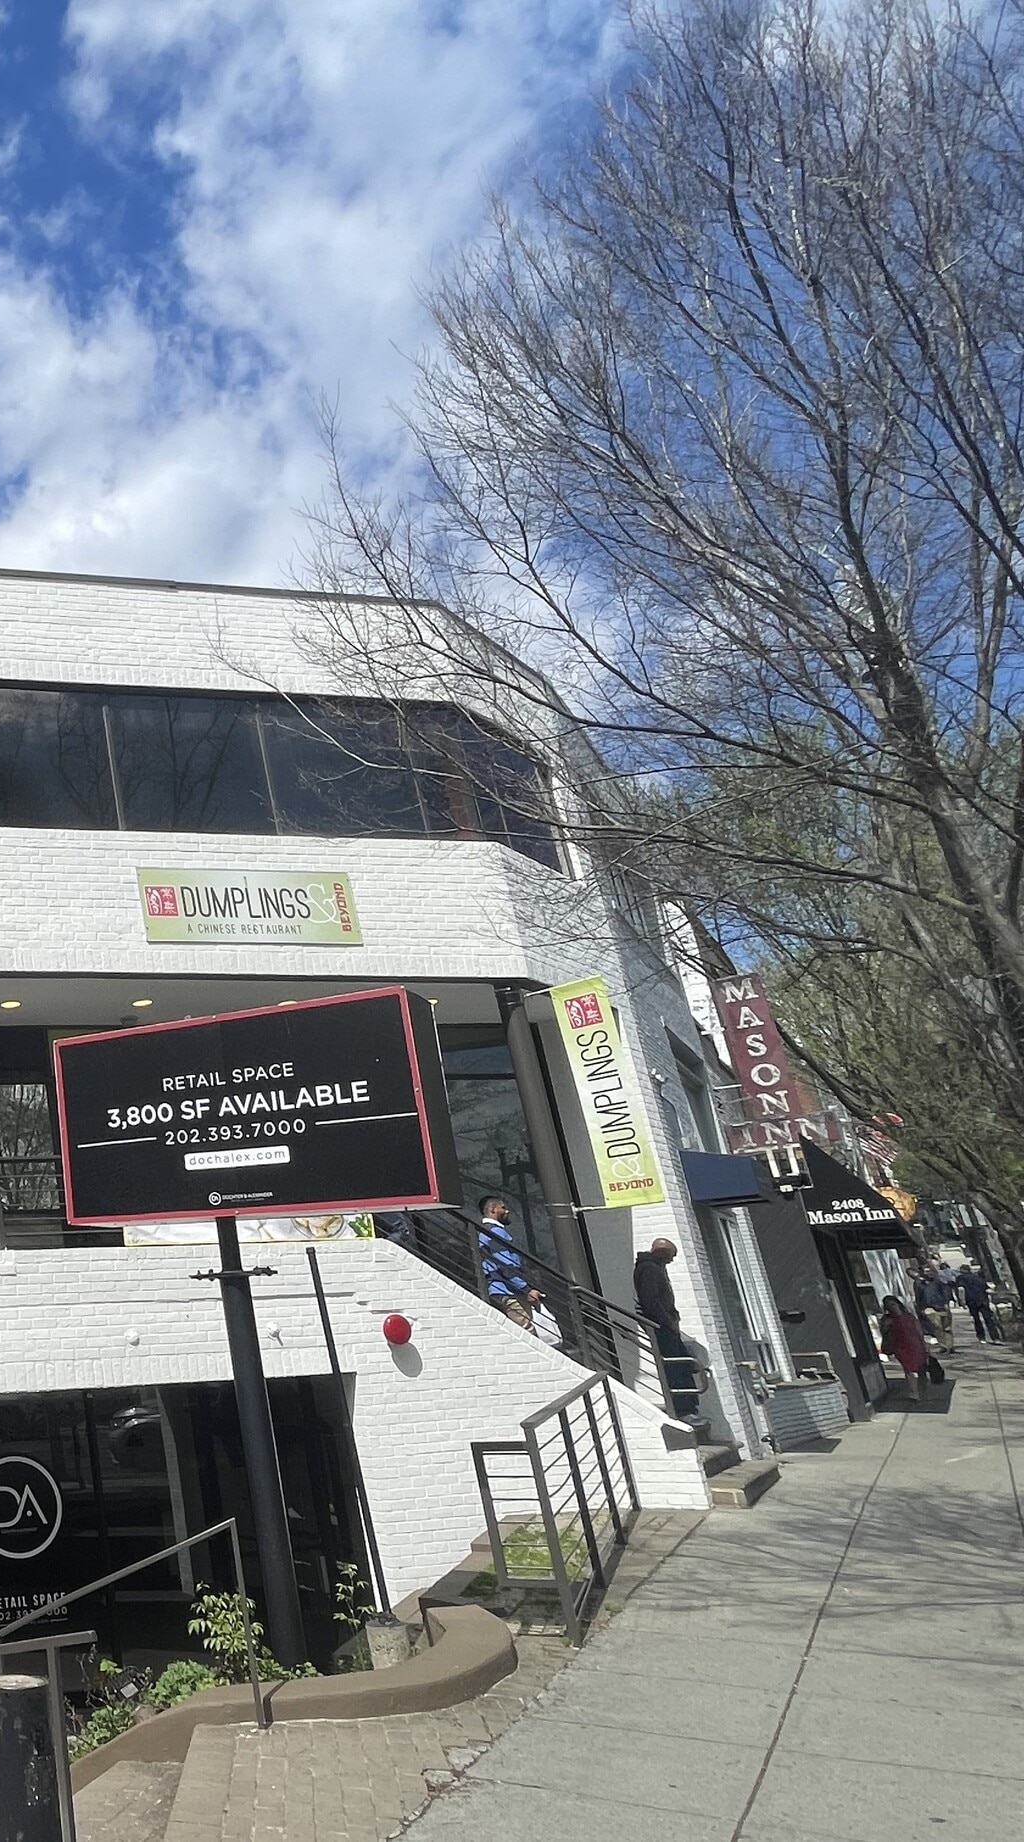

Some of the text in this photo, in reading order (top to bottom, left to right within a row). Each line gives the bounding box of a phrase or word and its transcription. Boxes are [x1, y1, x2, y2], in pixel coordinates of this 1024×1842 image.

[180, 877, 311, 920] DUMPLINGS
[333, 883, 353, 932] BEYOND
[187, 923, 303, 936] A CHINESE RESTAURANT
[723, 977, 791, 1117] MASON
[162, 1062, 295, 1092] RETAIL SPACE
[107, 1080, 371, 1130] 3,800 SF AVAILABLE
[576, 1029, 641, 1159] DUMPLINGS
[164, 1118, 307, 1146] 202.393.7000
[188, 1148, 286, 1167] dochalex.com
[609, 1178, 654, 1192] BEYOND
[807, 1208, 896, 1225] Mason Inn
[831, 1198, 865, 1211] 2408
